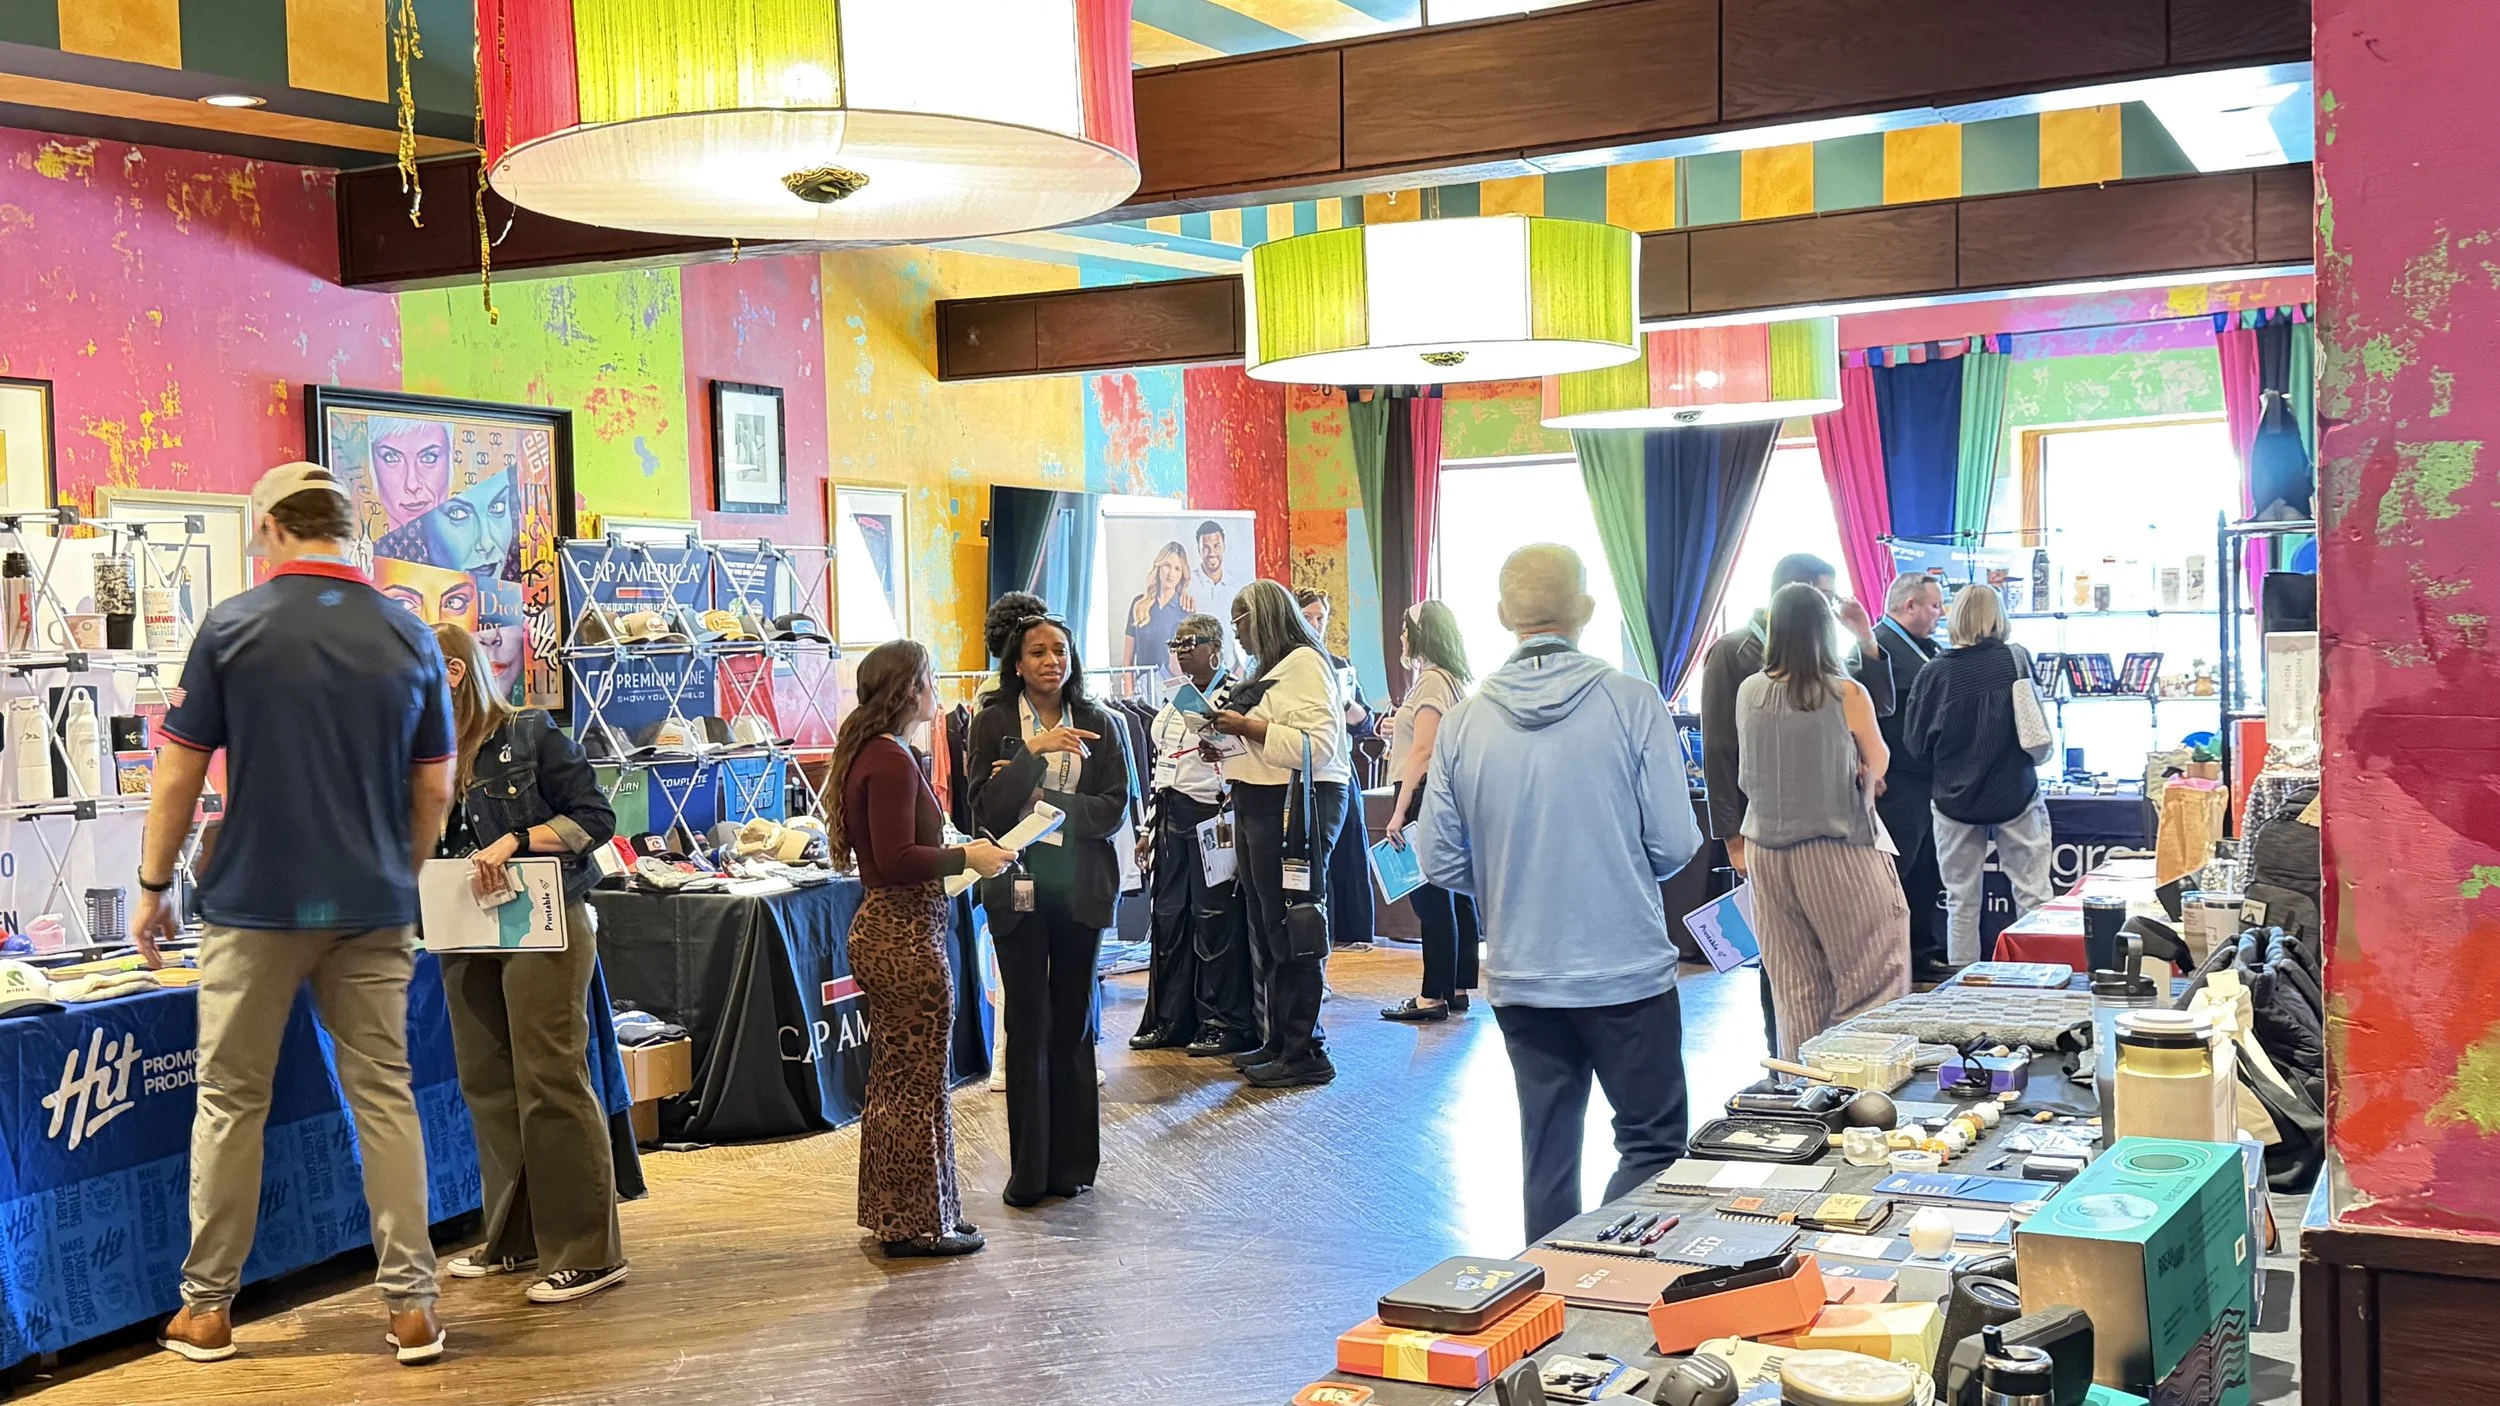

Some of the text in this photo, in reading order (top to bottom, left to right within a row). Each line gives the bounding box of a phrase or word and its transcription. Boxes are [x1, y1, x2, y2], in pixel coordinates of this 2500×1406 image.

[616, 672, 675, 689] PREMIUM
[542, 892, 554, 931] Printable
[42, 1027, 143, 1151] Hit
